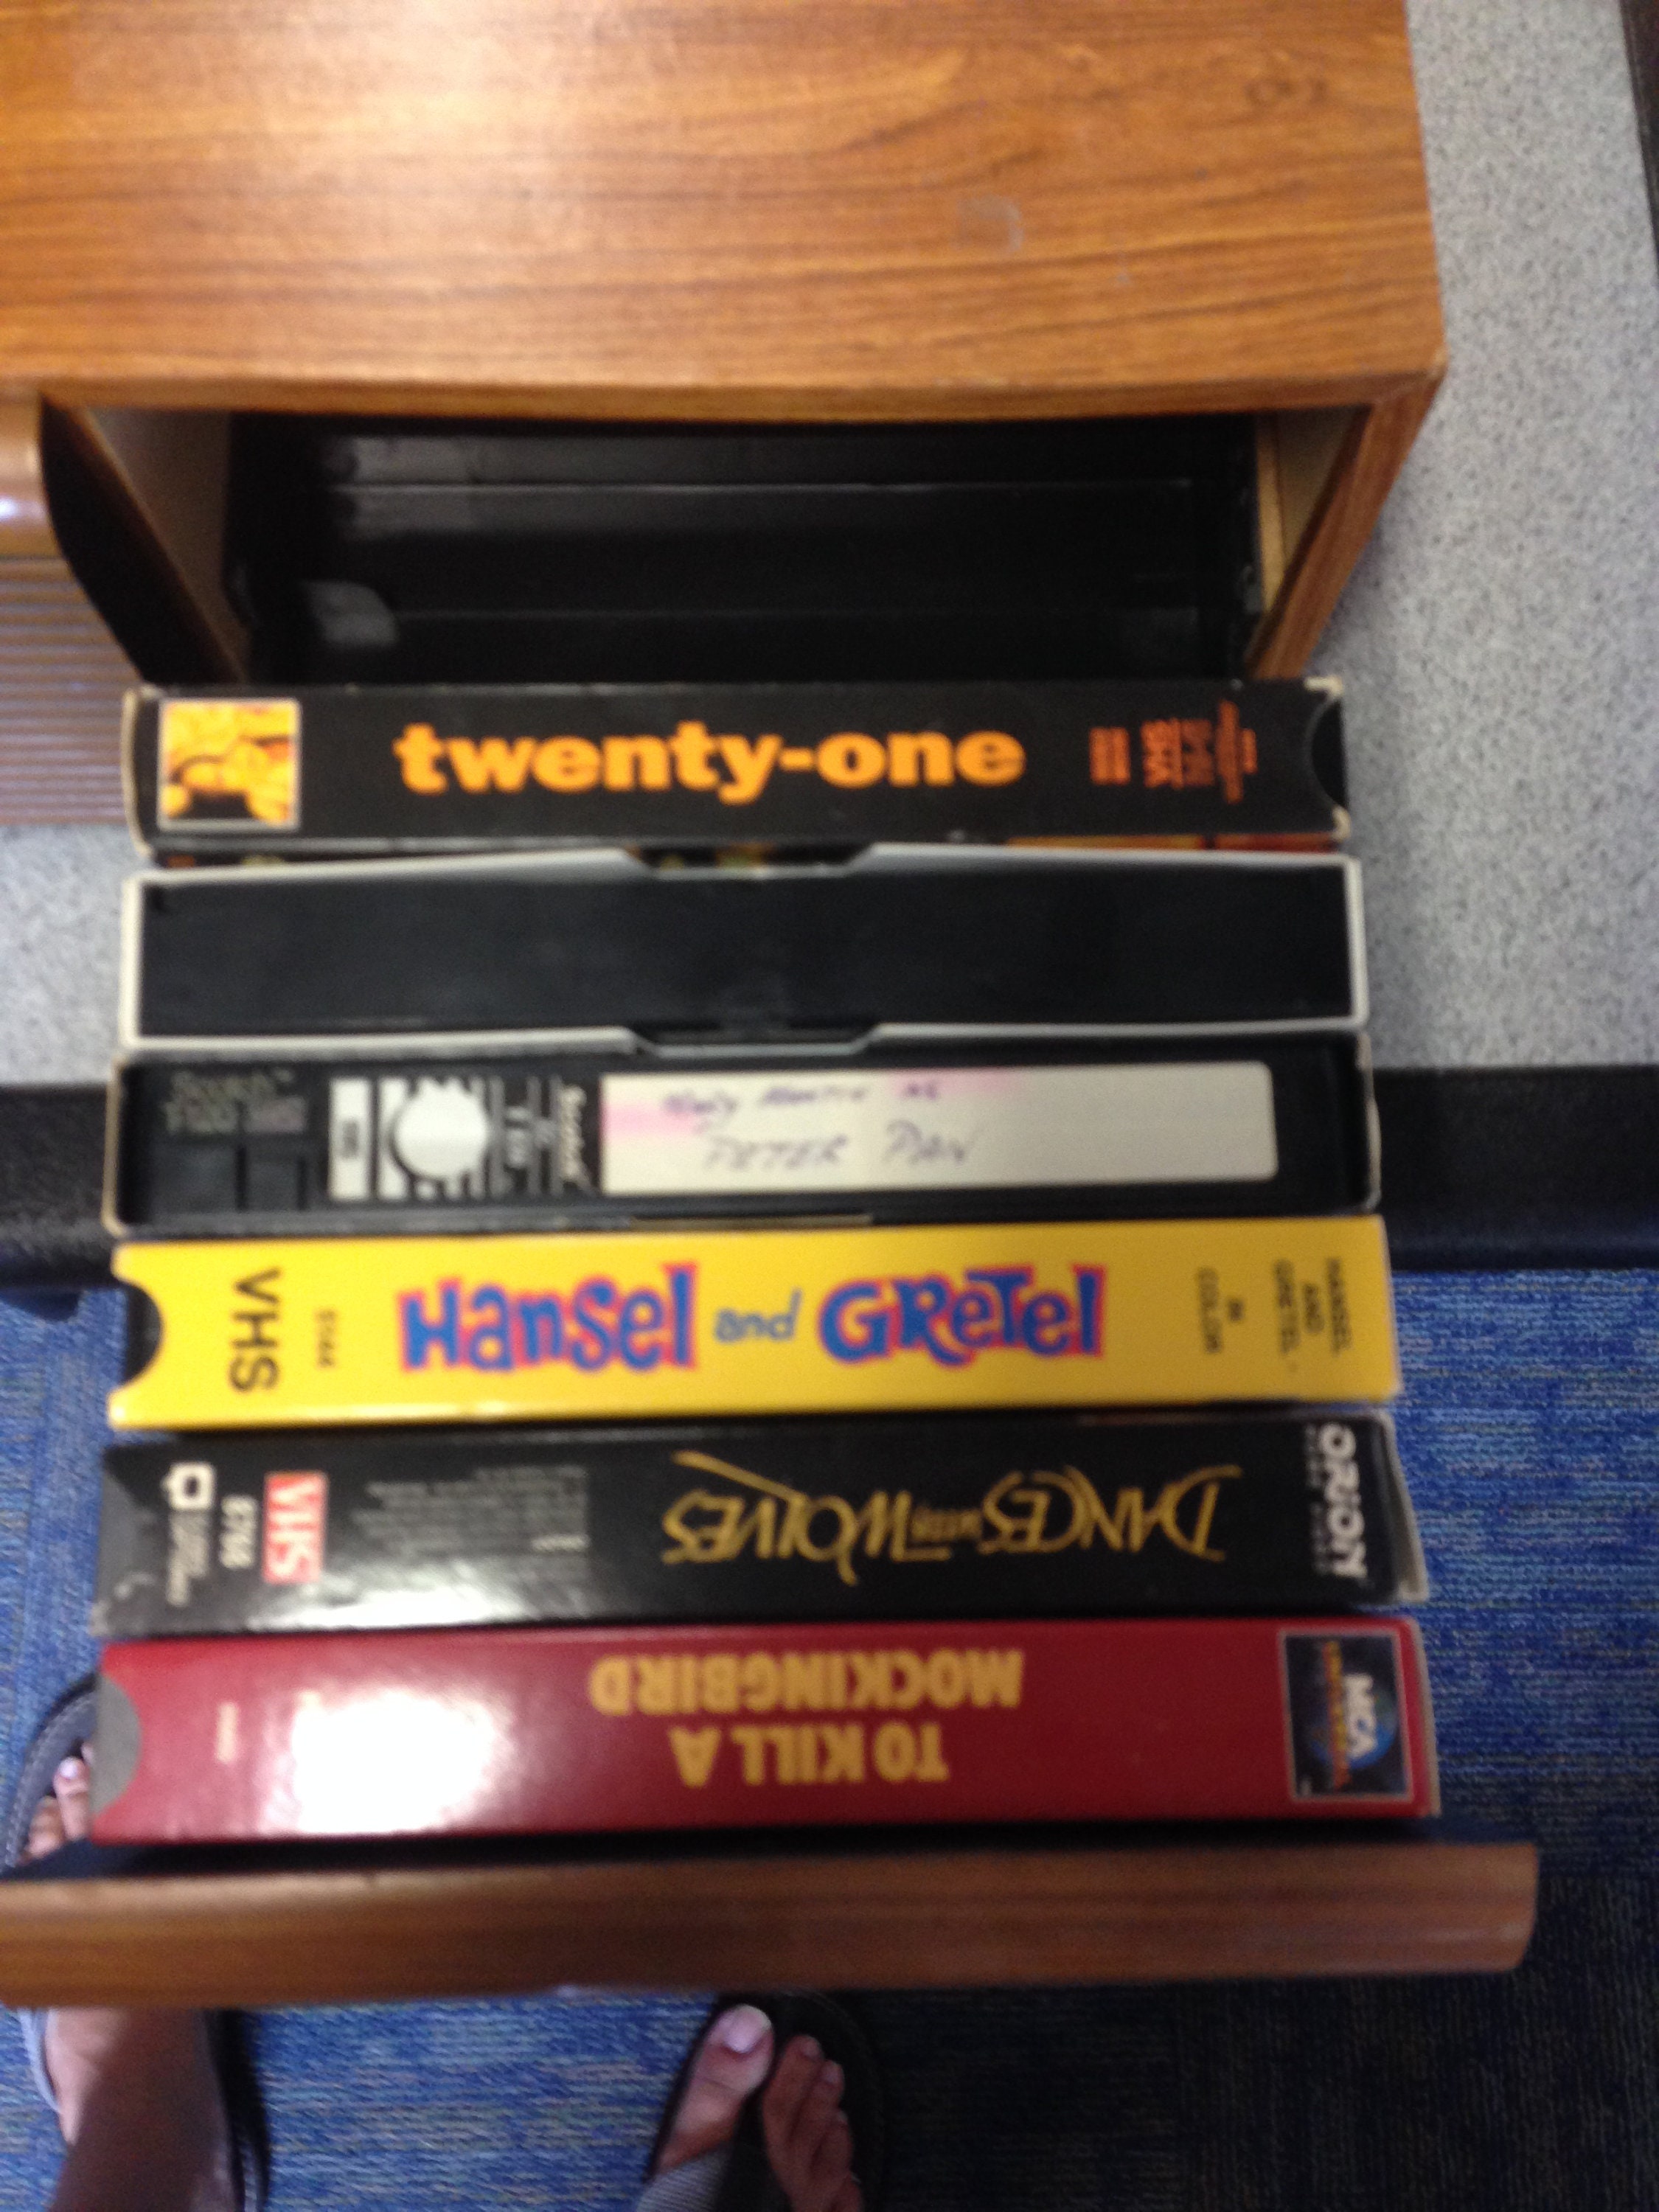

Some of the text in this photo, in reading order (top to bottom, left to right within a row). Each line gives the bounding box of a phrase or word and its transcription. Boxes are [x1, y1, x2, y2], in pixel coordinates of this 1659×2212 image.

[394, 720, 1026, 804] twenty-one
[228, 1267, 281, 1394] VHS
[396, 1259, 701, 1374] Hansel
[712, 1287, 803, 1344] and
[590, 1648, 1025, 1717] MOCKINGBIRD
[668, 1721, 950, 1788] TO KILL A
